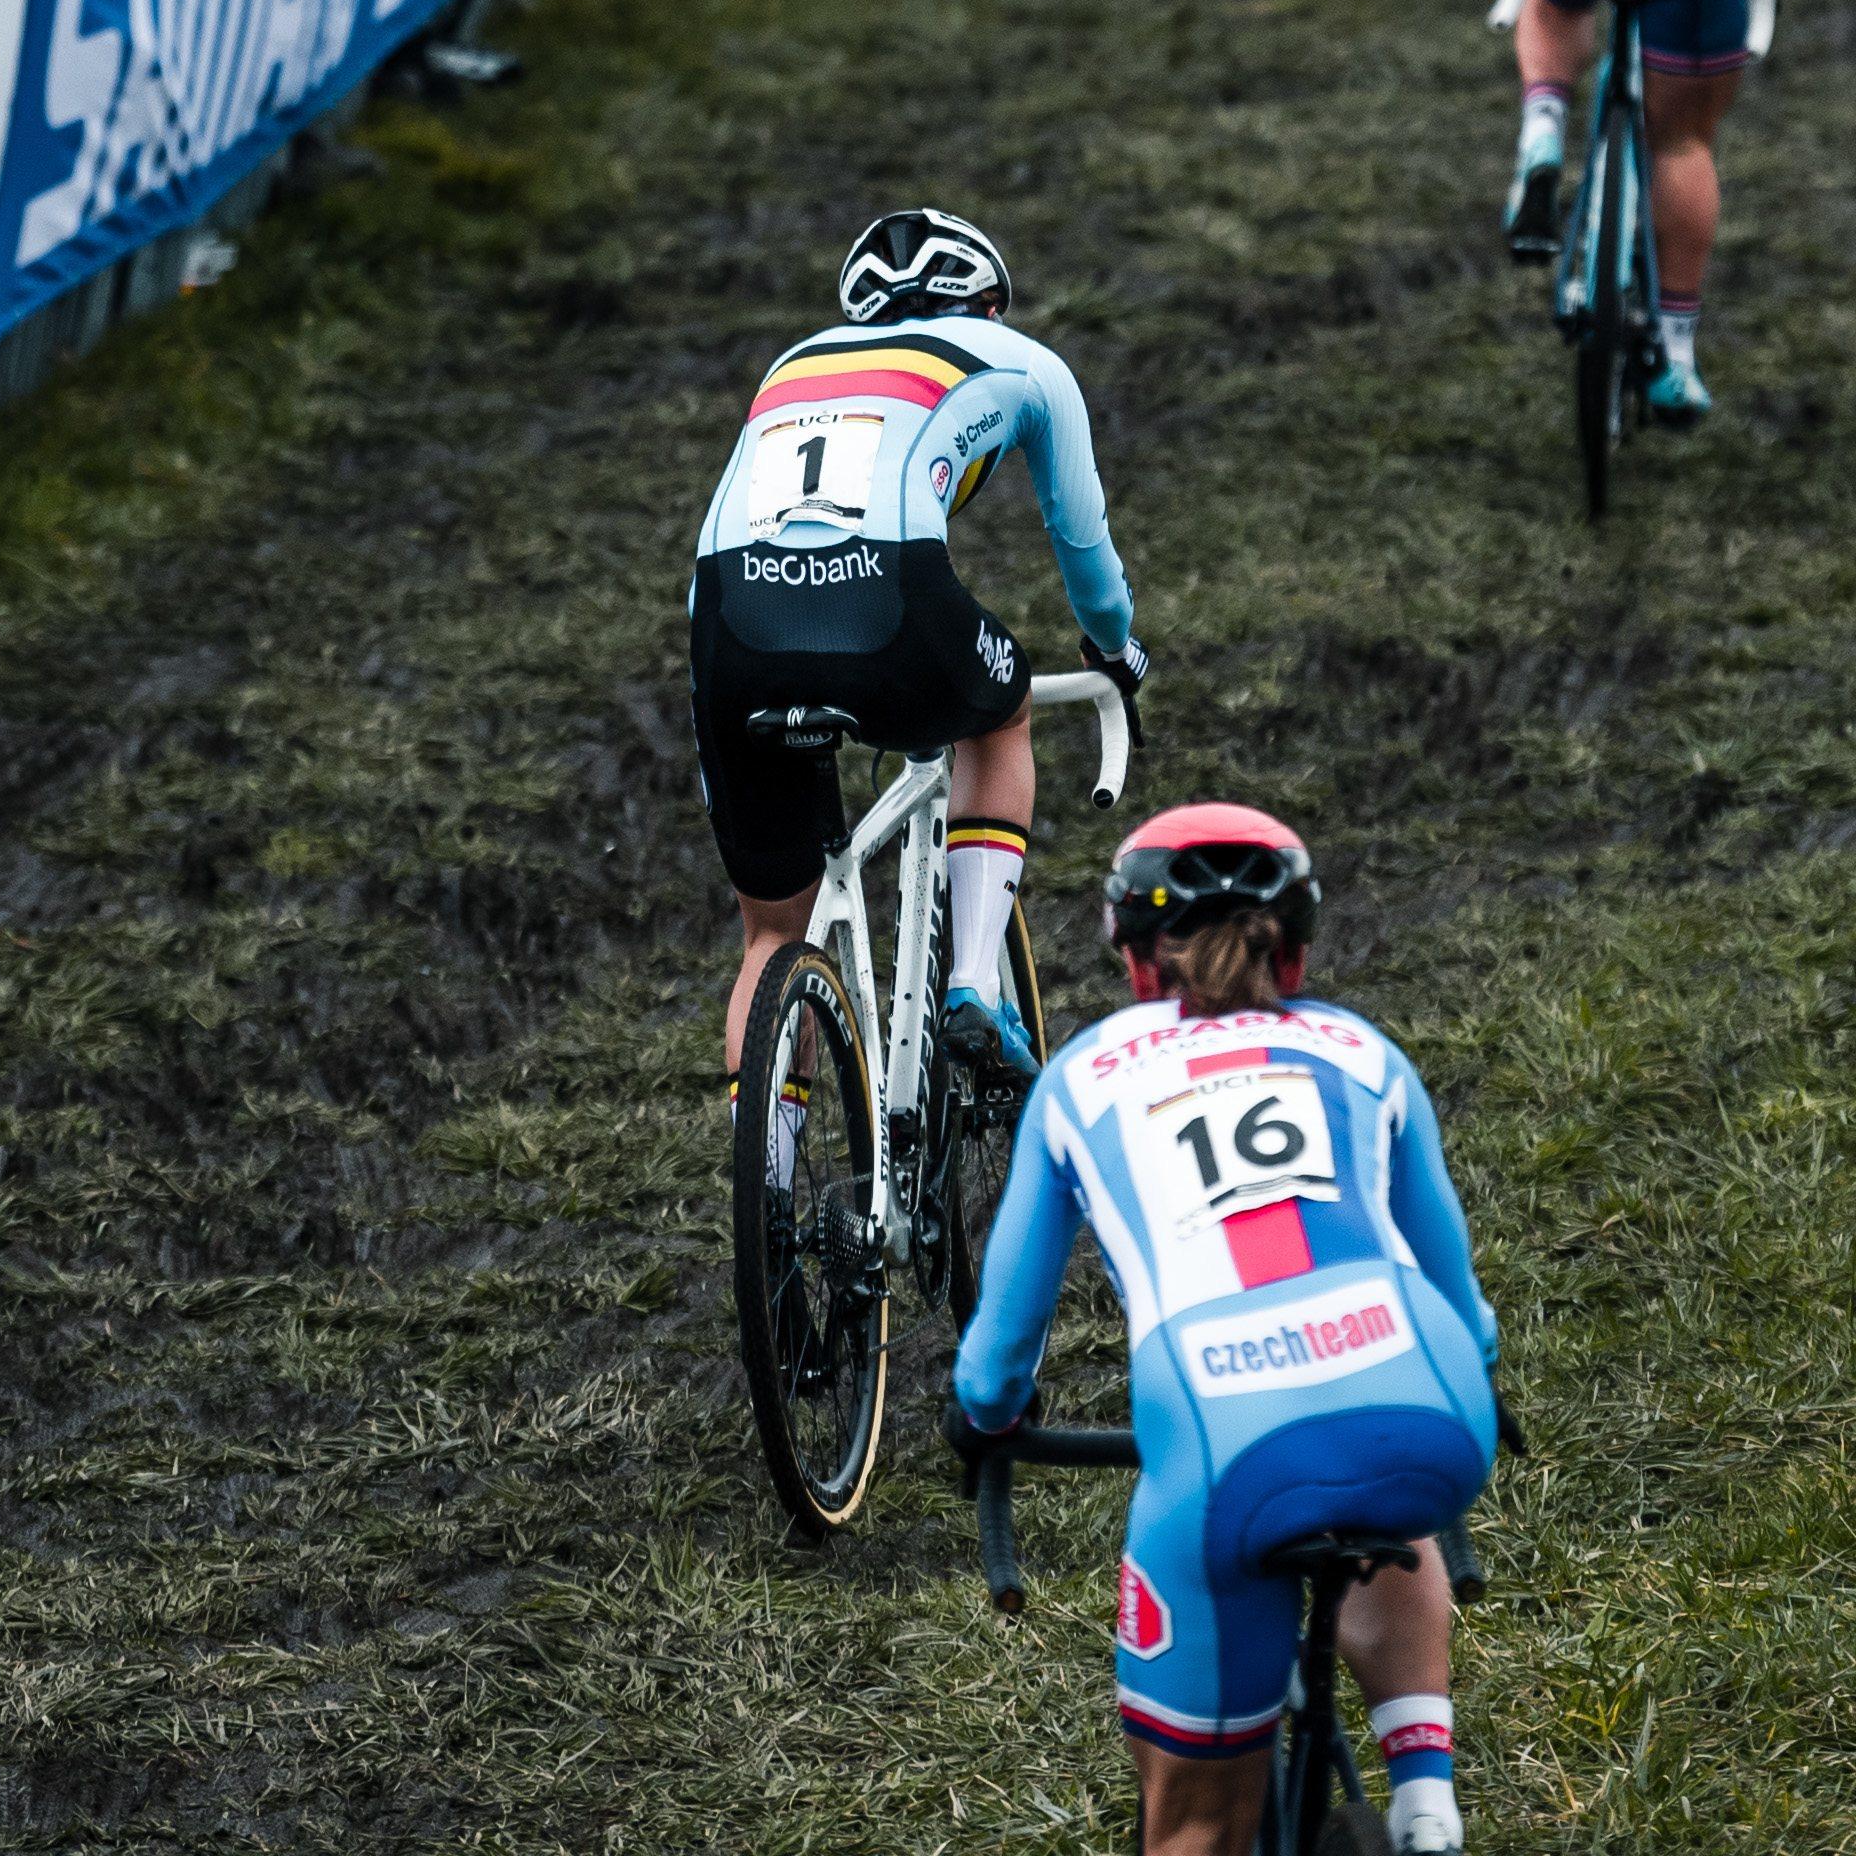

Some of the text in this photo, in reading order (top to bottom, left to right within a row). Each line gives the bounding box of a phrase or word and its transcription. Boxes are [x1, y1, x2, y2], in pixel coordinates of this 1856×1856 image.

[932, 280, 969, 292] LAZER
[857, 295, 882, 319] LAZER
[798, 413, 839, 428] UCI
[966, 408, 1004, 443] Crelan
[796, 435, 827, 496] 1
[785, 732, 824, 746] ITALIA
[1092, 1012, 1363, 1079] STRABAG
[1197, 1073, 1254, 1096] UCI
[1176, 1094, 1306, 1189] 16
[1200, 1303, 1397, 1378] czechteam
